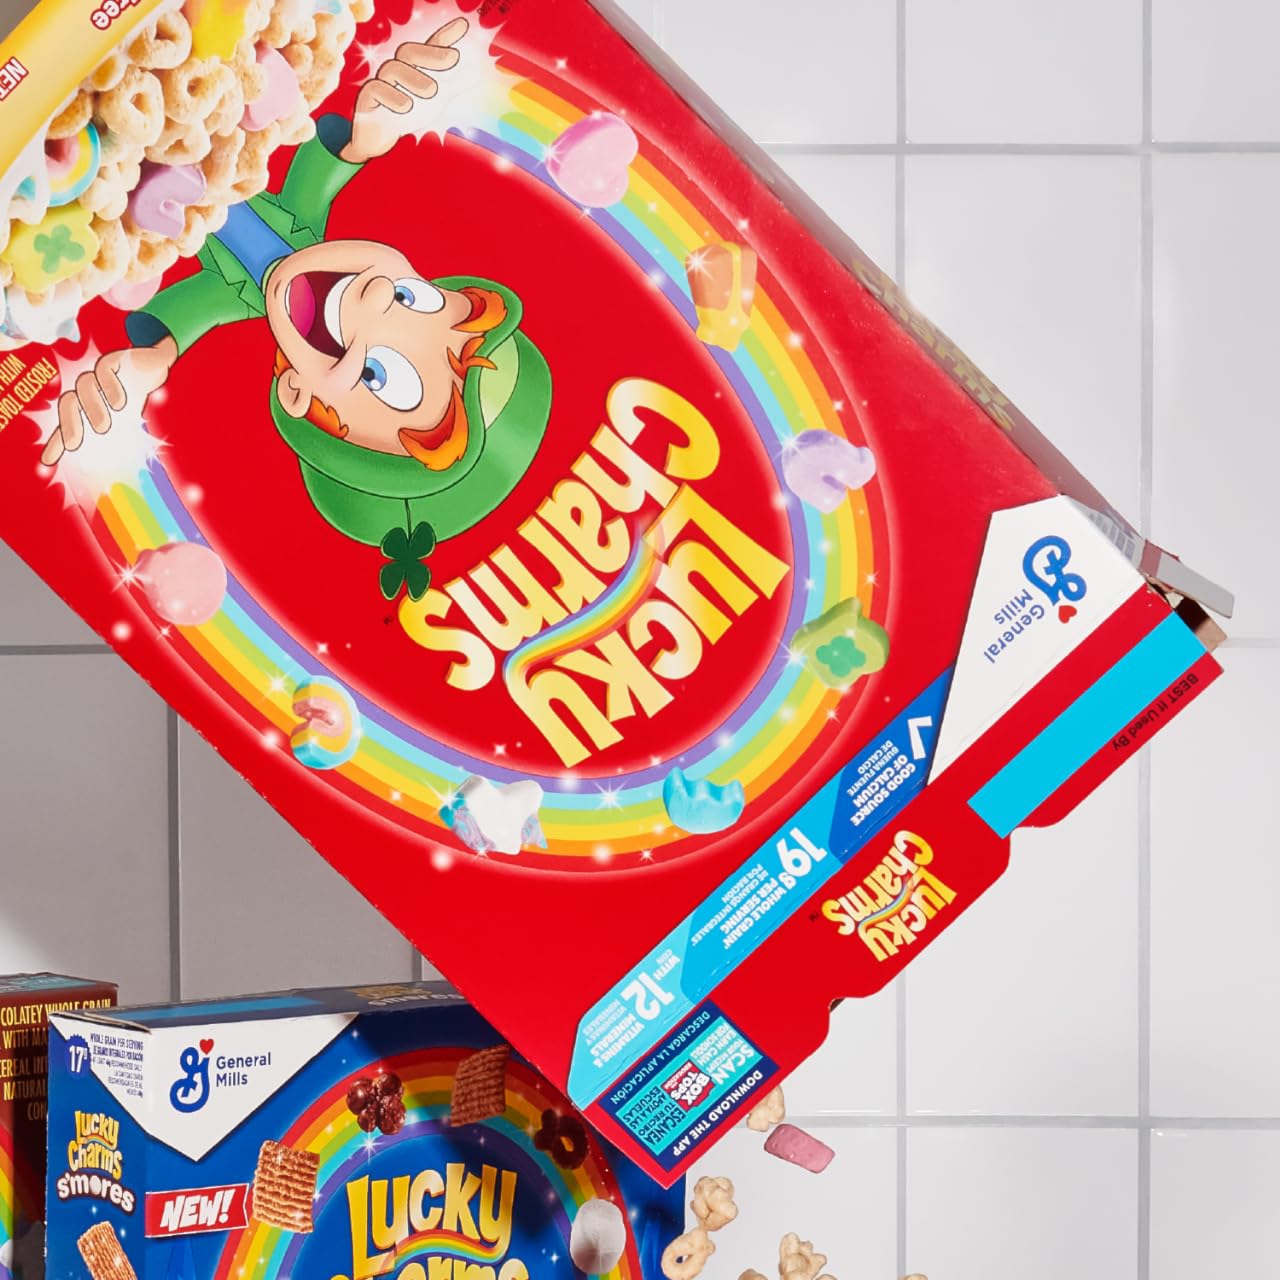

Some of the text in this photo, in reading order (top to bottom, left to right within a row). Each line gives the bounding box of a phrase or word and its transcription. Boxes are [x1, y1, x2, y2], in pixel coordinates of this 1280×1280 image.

[11, 356, 58, 403] FROSTED
[398, 377, 721, 691] Charms
[502, 482, 791, 768] Lucky
[994, 590, 1032, 625] Mills
[984, 603, 1045, 664] General
[1109, 670, 1199, 753] BEST If Used By
[846, 745, 899, 796] BUENA FUENTE
[856, 739, 893, 775] DE CALCIO
[849, 761, 917, 826] GOOD SOURCE
[852, 753, 908, 808] OF CALCIUM
[775, 826, 828, 887] 19g
[749, 885, 787, 921] WHOLE
[821, 830, 934, 935] Charms
[718, 877, 779, 934] PER SERVING
[858, 866, 957, 961] Lucky
[652, 953, 681, 981] WITH
[620, 972, 674, 1020] 12
[3, 1030, 29, 1049] WITH
[599, 1020, 645, 1061] VITAMINS
[607, 1010, 712, 1105] DESCARGA LA APLICACIÓN
[216, 1052, 271, 1070] General
[217, 1072, 248, 1088] Mills
[661, 1061, 693, 1089] EDUCATION
[668, 1063, 695, 1090] TOPS
[710, 1043, 756, 1084] SCAN
[620, 1086, 661, 1121] ESCUELAS
[644, 1093, 667, 1114] APOYA
[685, 1073, 713, 1105] BOX
[75, 1110, 119, 1150] Lucky
[629, 1115, 643, 1129] LAS
[636, 1101, 675, 1136] TU RECIBO
[641, 1106, 687, 1147] ESCANEA
[669, 1068, 765, 1156] DOWNLOAD THE APP
[68, 1140, 123, 1180] Charms
[57, 1172, 135, 1213] s'mores
[160, 1189, 231, 1231] NEW!
